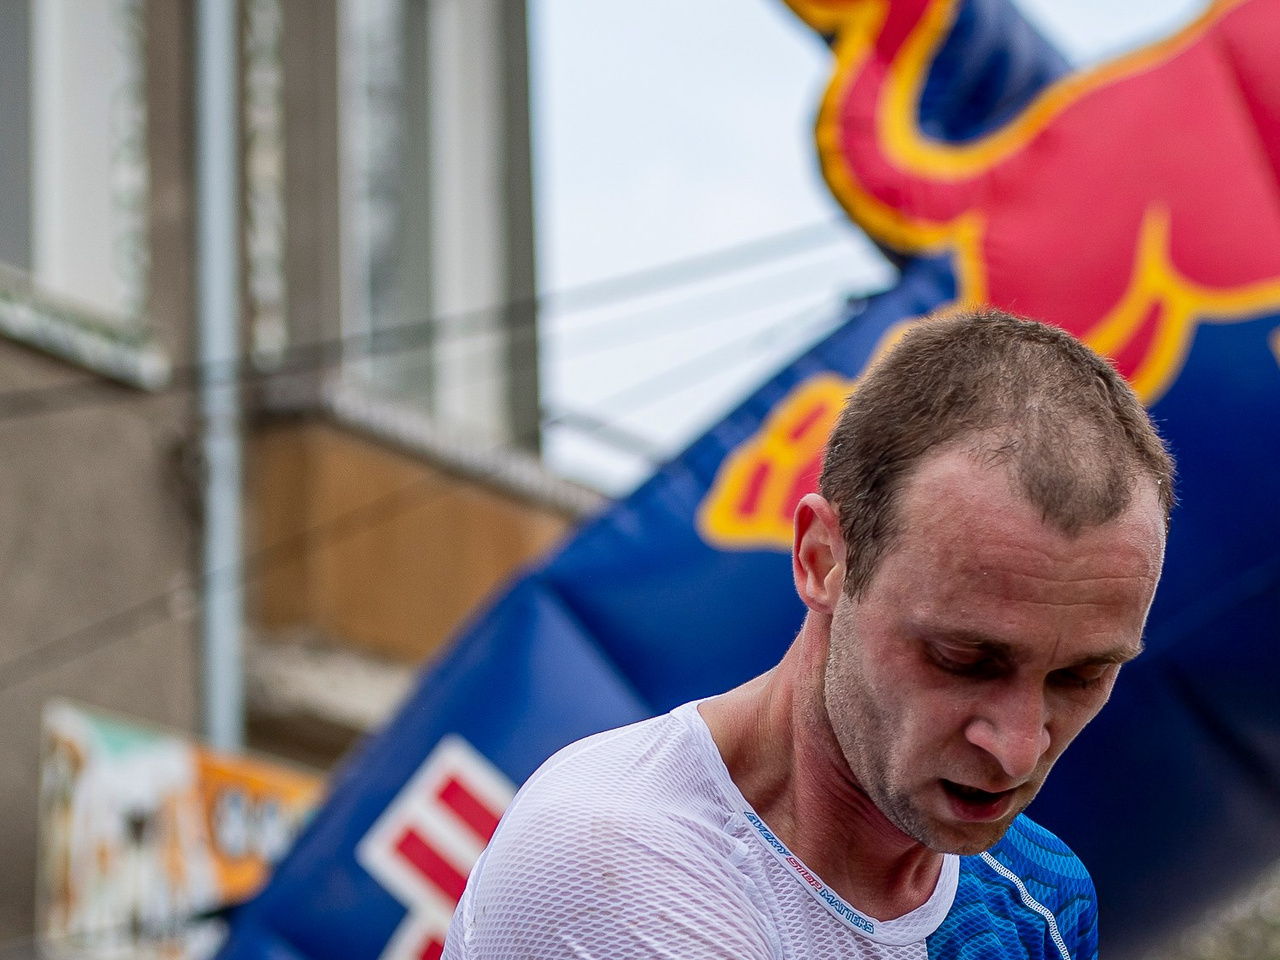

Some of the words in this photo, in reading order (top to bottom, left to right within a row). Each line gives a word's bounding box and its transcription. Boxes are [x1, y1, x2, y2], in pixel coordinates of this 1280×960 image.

[744, 811, 792, 857] EVERY
[786, 857, 823, 891] STEP
[819, 888, 875, 934] MATTERS
